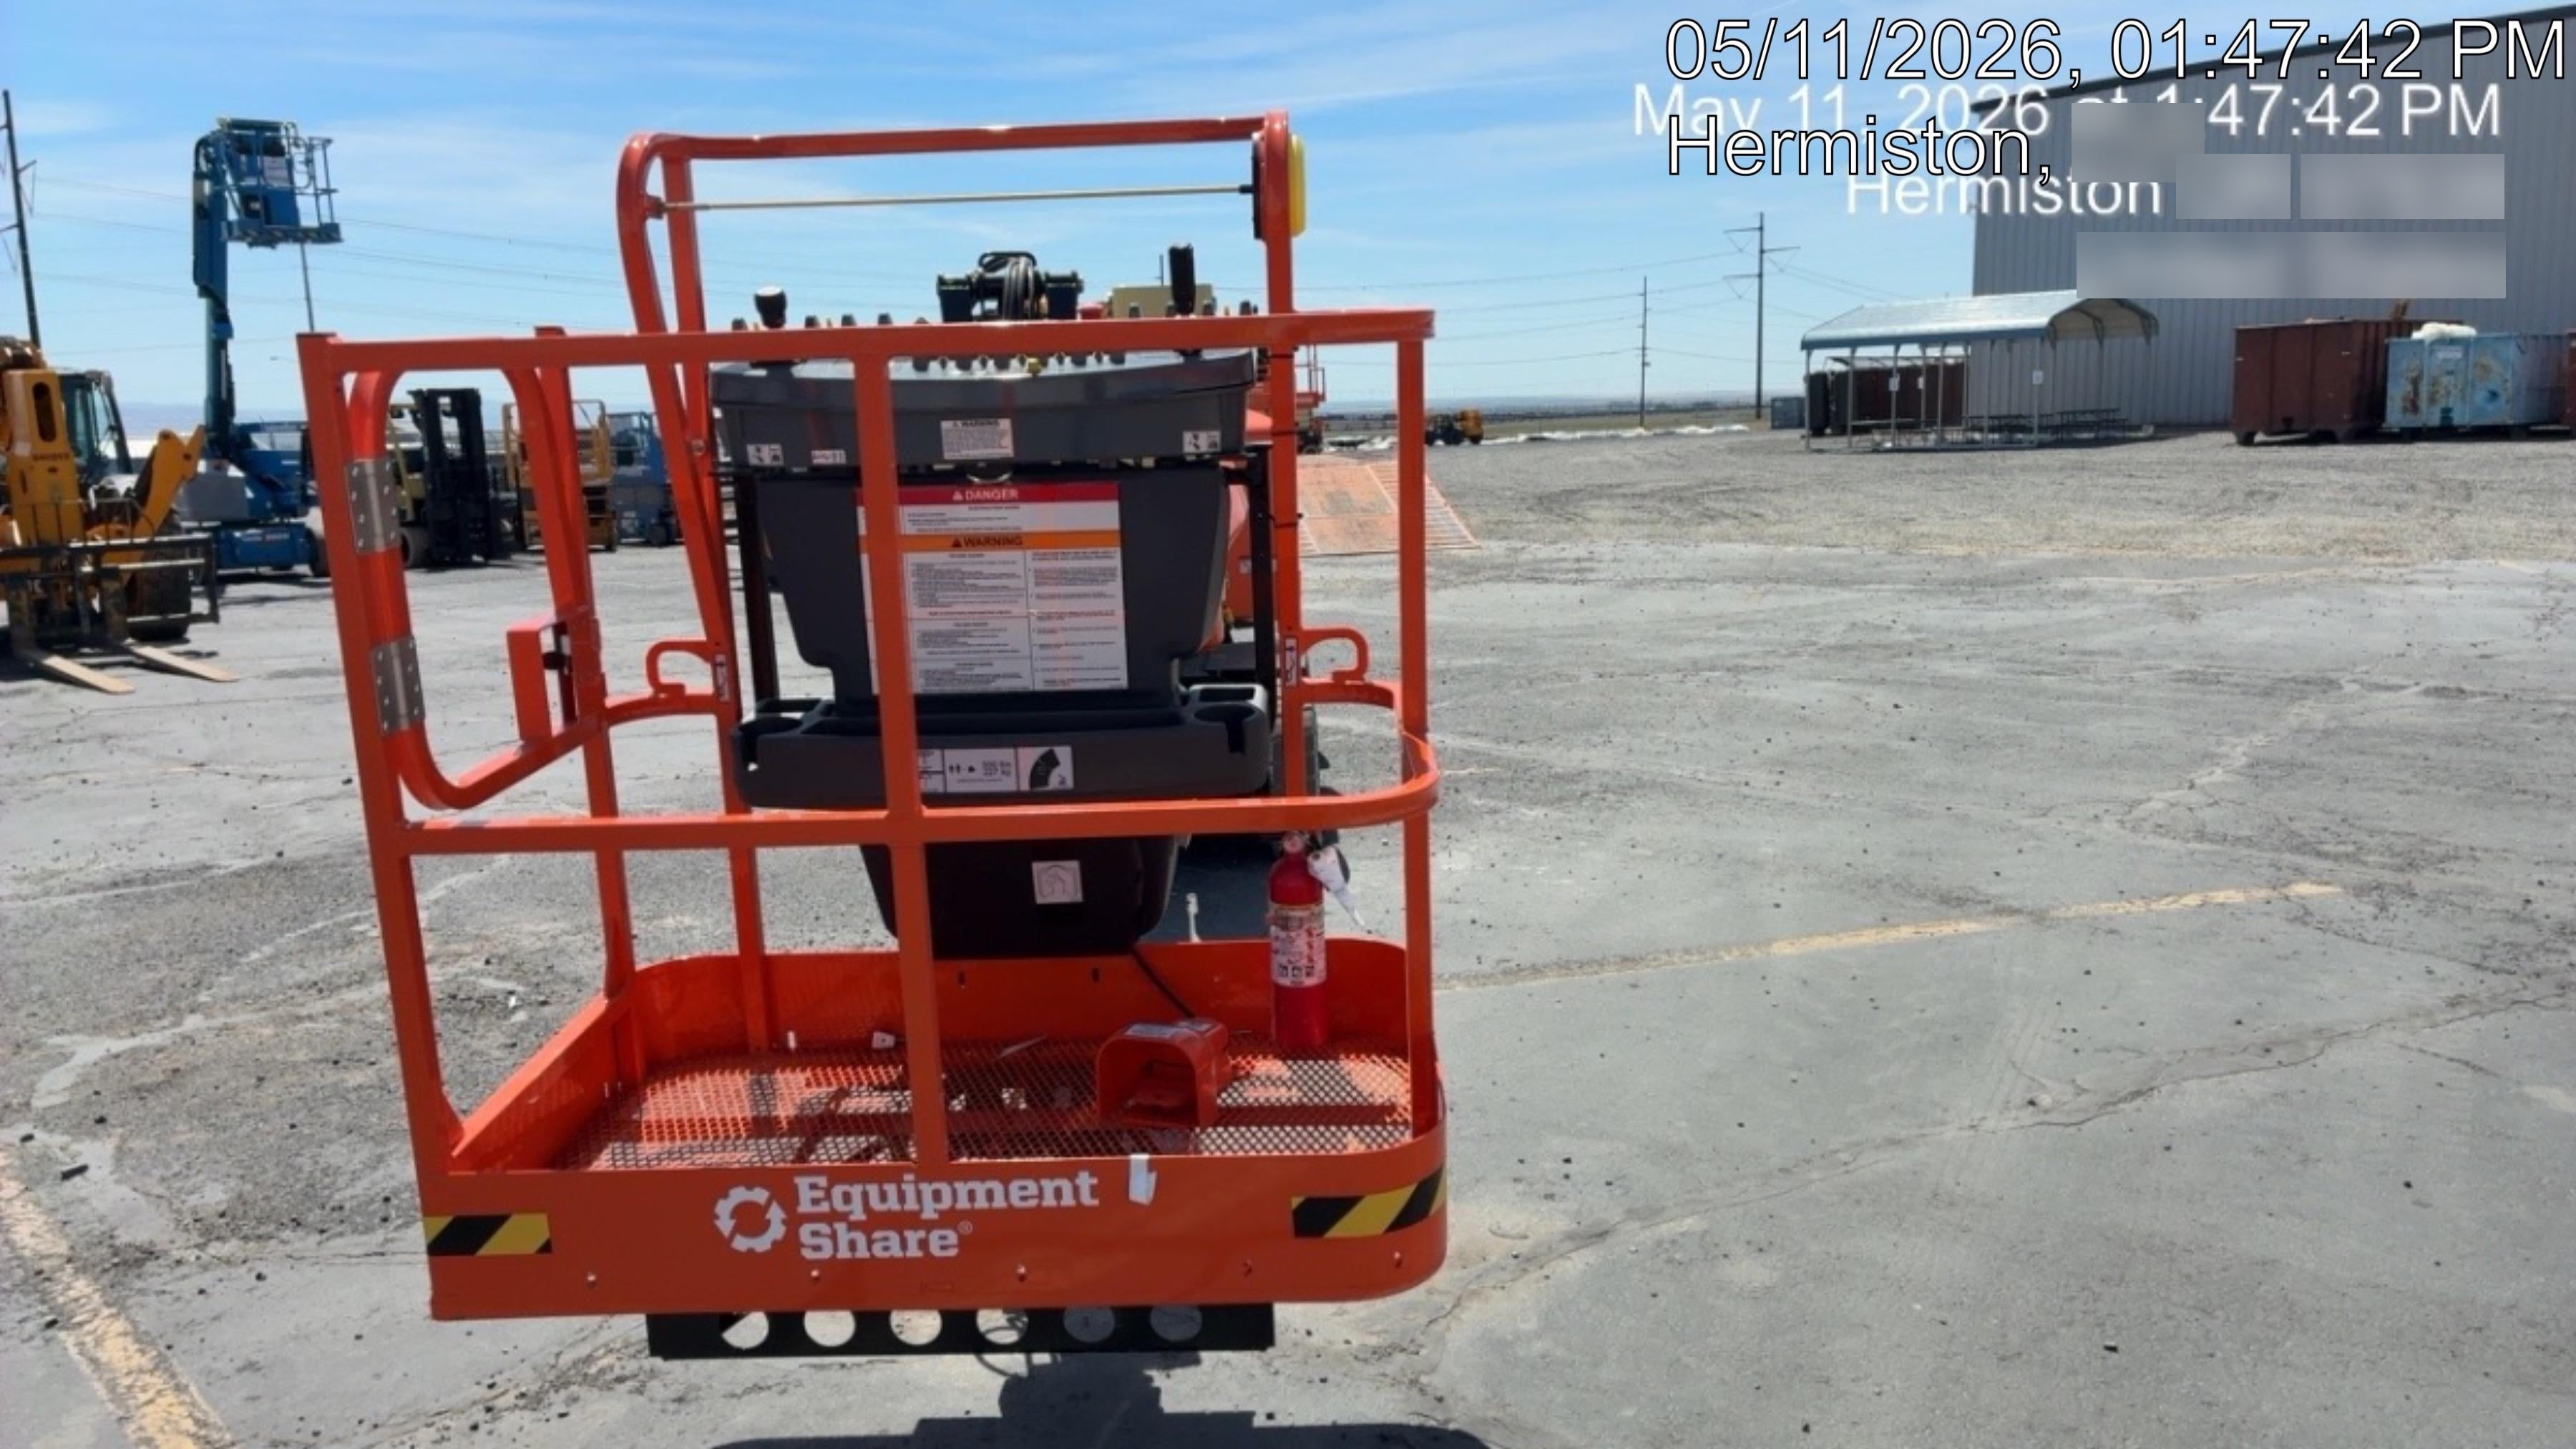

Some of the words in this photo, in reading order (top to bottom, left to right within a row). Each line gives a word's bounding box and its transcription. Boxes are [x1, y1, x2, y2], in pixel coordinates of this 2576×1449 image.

[965, 489, 1019, 501] DANGER
[963, 536, 1023, 548] WARNING
[794, 1170, 1099, 1220] Equipment
